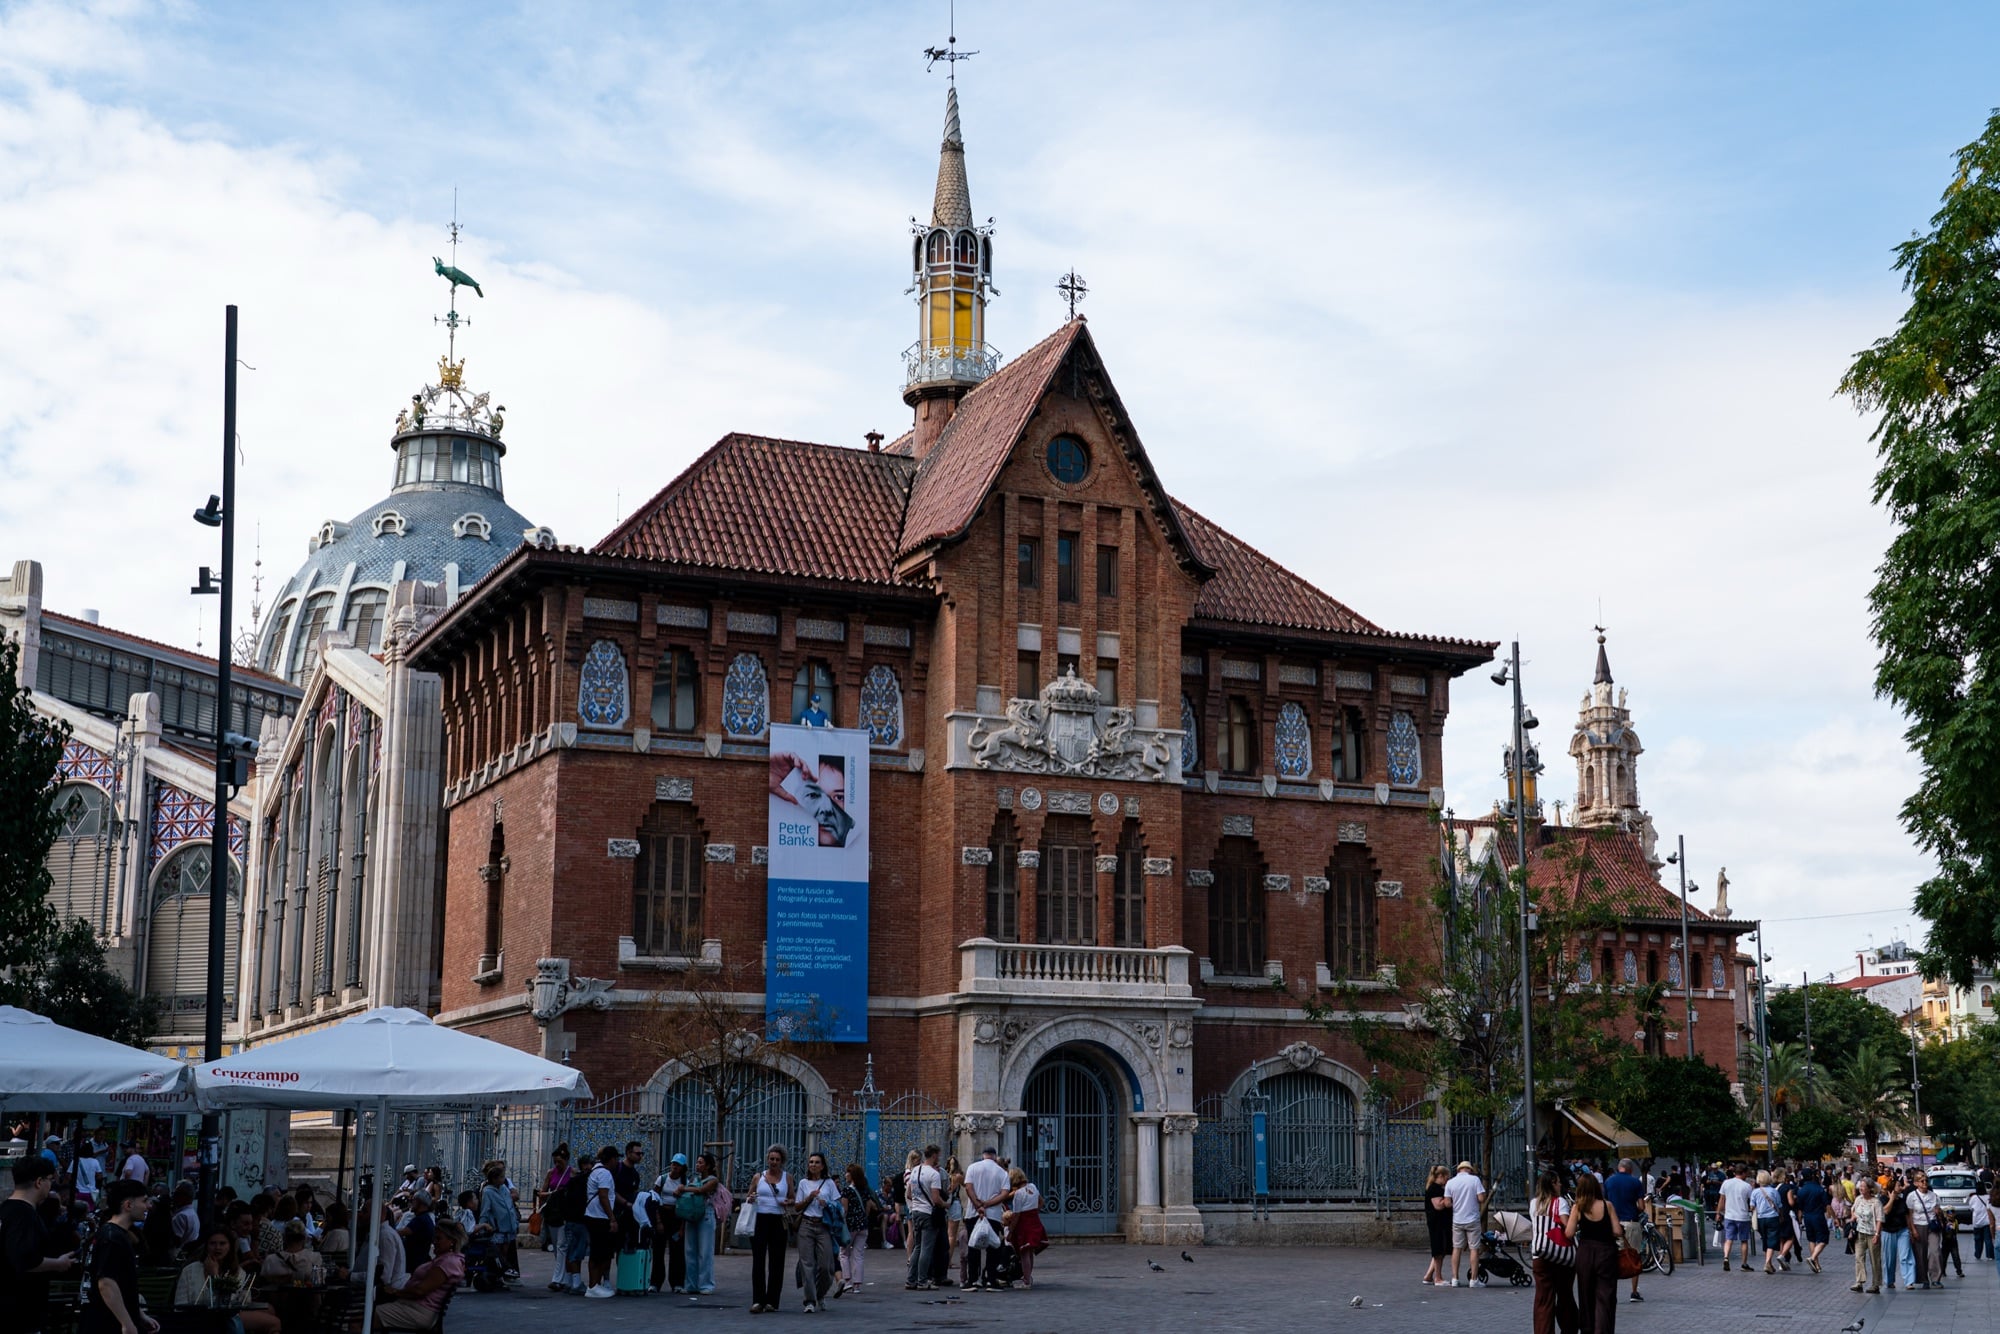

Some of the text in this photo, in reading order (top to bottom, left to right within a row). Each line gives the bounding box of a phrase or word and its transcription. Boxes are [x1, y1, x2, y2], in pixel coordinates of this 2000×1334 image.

[779, 822, 811, 834] Peter
[779, 834, 815, 847] Banks
[777, 886, 804, 894] Perfecta
[805, 887, 825, 895] fusión
[777, 911, 787, 919] No
[800, 911, 818, 919] fotos
[830, 912, 858, 920] historias
[776, 936, 794, 944] Lleno
[795, 936, 804, 944] de
[775, 970, 781, 978] y
[212, 1068, 300, 1083] Cruzcampo
